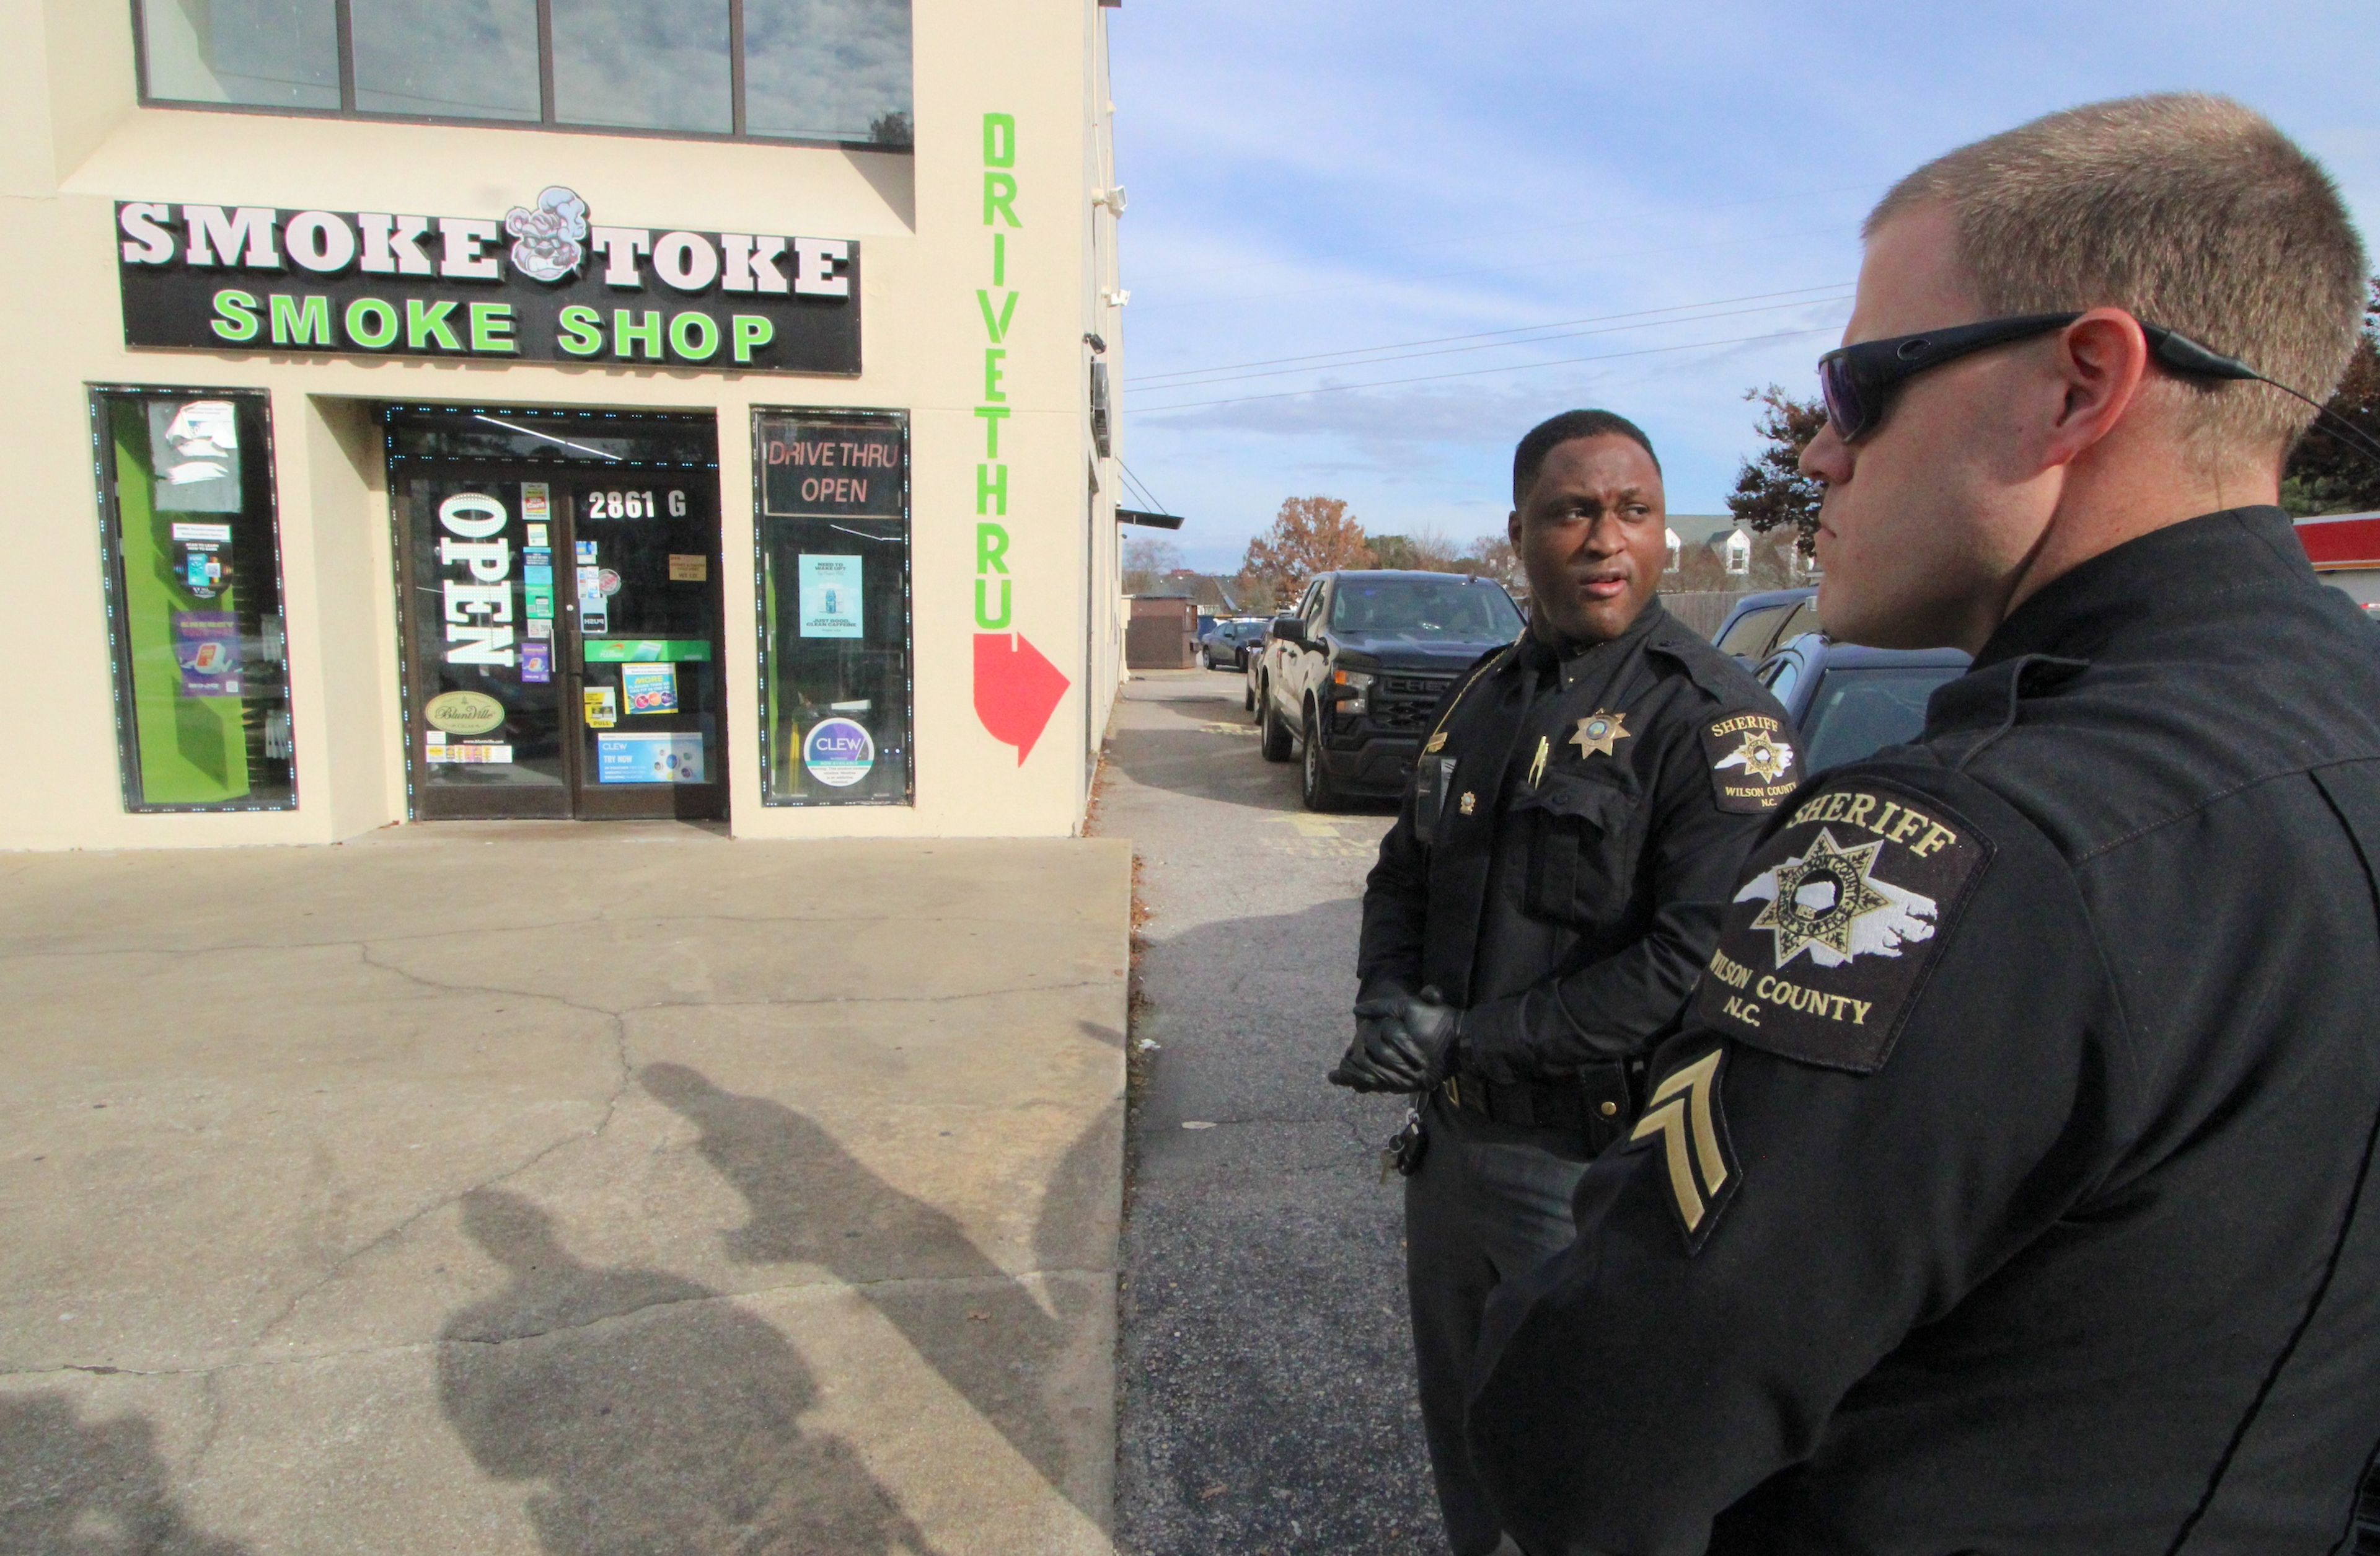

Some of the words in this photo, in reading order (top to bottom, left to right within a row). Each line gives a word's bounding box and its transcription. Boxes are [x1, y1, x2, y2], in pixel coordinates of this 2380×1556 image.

[120, 202, 498, 278] SMOKE
[593, 227, 849, 296] TOKE
[976, 113, 1023, 402] DRIVE
[210, 289, 515, 351] SMOKE
[557, 306, 774, 362] SHOP
[769, 440, 835, 466] DRIVE
[840, 442, 898, 467] THRU
[589, 491, 654, 519] 2861
[668, 490, 686, 518] G
[801, 478, 867, 503] OPEN
[974, 406, 1011, 629] THRU
[439, 492, 514, 668] OPEN
[635, 676, 663, 685] MORE
[1711, 715, 1779, 737] SHERIFF
[604, 755, 615, 763] TRY
[617, 755, 632, 763] NOW
[816, 738, 862, 751] CLEW
[1726, 786, 1765, 797] WILSON
[1761, 798, 1777, 807] N.C.
[1785, 792, 1957, 858] SHERIFF
[1709, 948, 1753, 989] WILSON
[1756, 975, 1873, 1025] COUNTY
[1722, 996, 1761, 1027] N.C.
